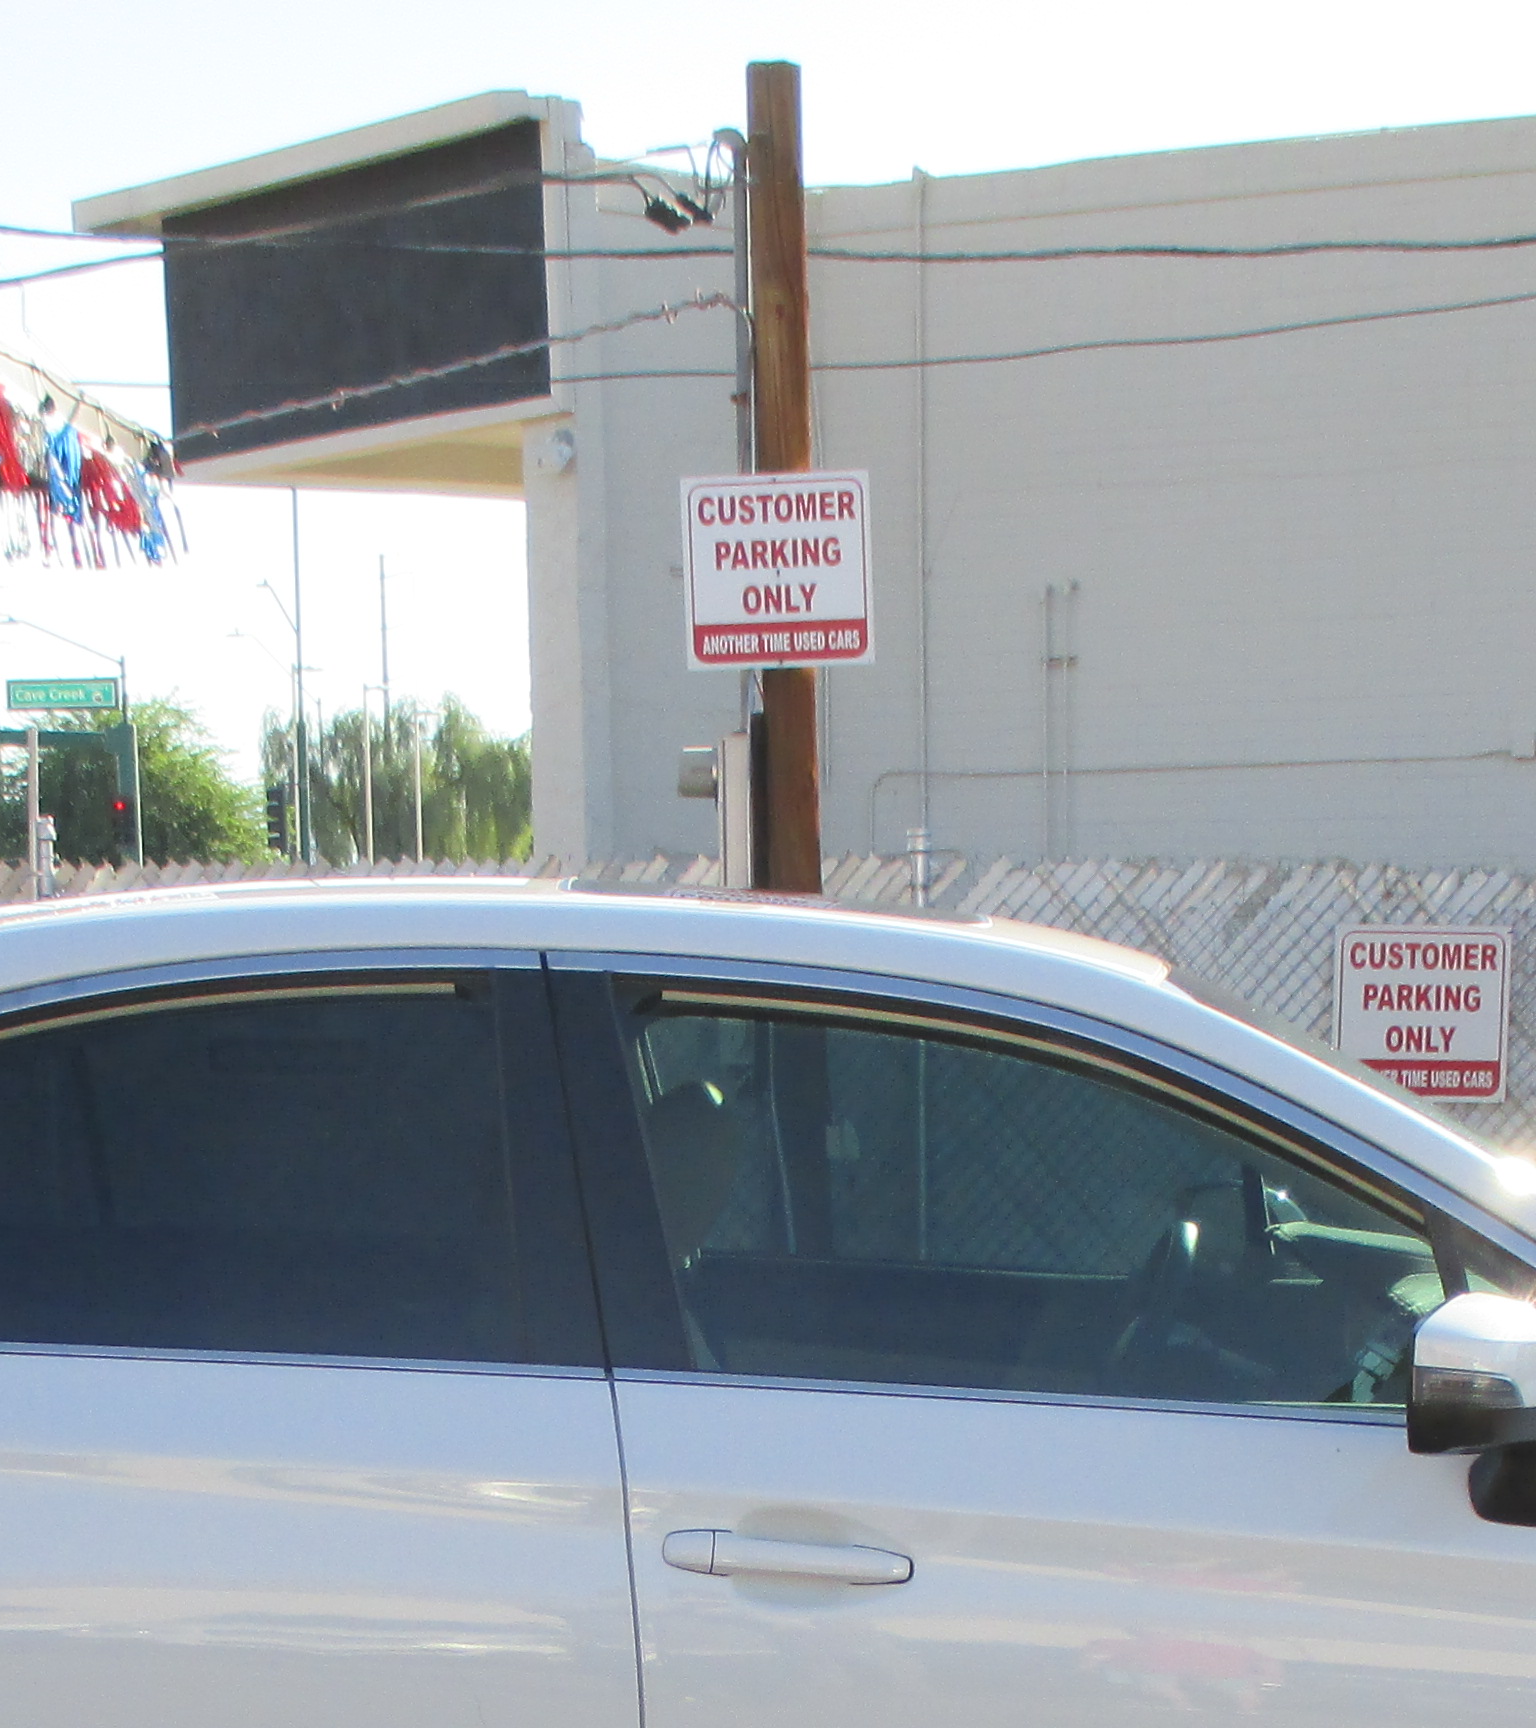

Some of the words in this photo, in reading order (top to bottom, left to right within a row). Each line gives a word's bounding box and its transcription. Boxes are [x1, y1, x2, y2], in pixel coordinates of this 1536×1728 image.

[697, 490, 856, 526] CUSTOMER
[715, 537, 842, 571] PARKING
[742, 583, 818, 615] ONLY
[702, 633, 760, 656] ANOTHER
[762, 632, 791, 652] TIME
[794, 630, 825, 651] USED
[828, 628, 860, 650] CARS
[14, 687, 47, 702] Cave
[49, 686, 86, 701] Creek
[1349, 941, 1498, 971] CUSTOMER
[1362, 983, 1482, 1013] PARKING
[1384, 1025, 1456, 1054] ONLY
[1401, 1070, 1428, 1088] TIME
[1430, 1070, 1460, 1088] USED
[1462, 1070, 1493, 1089] CARS
